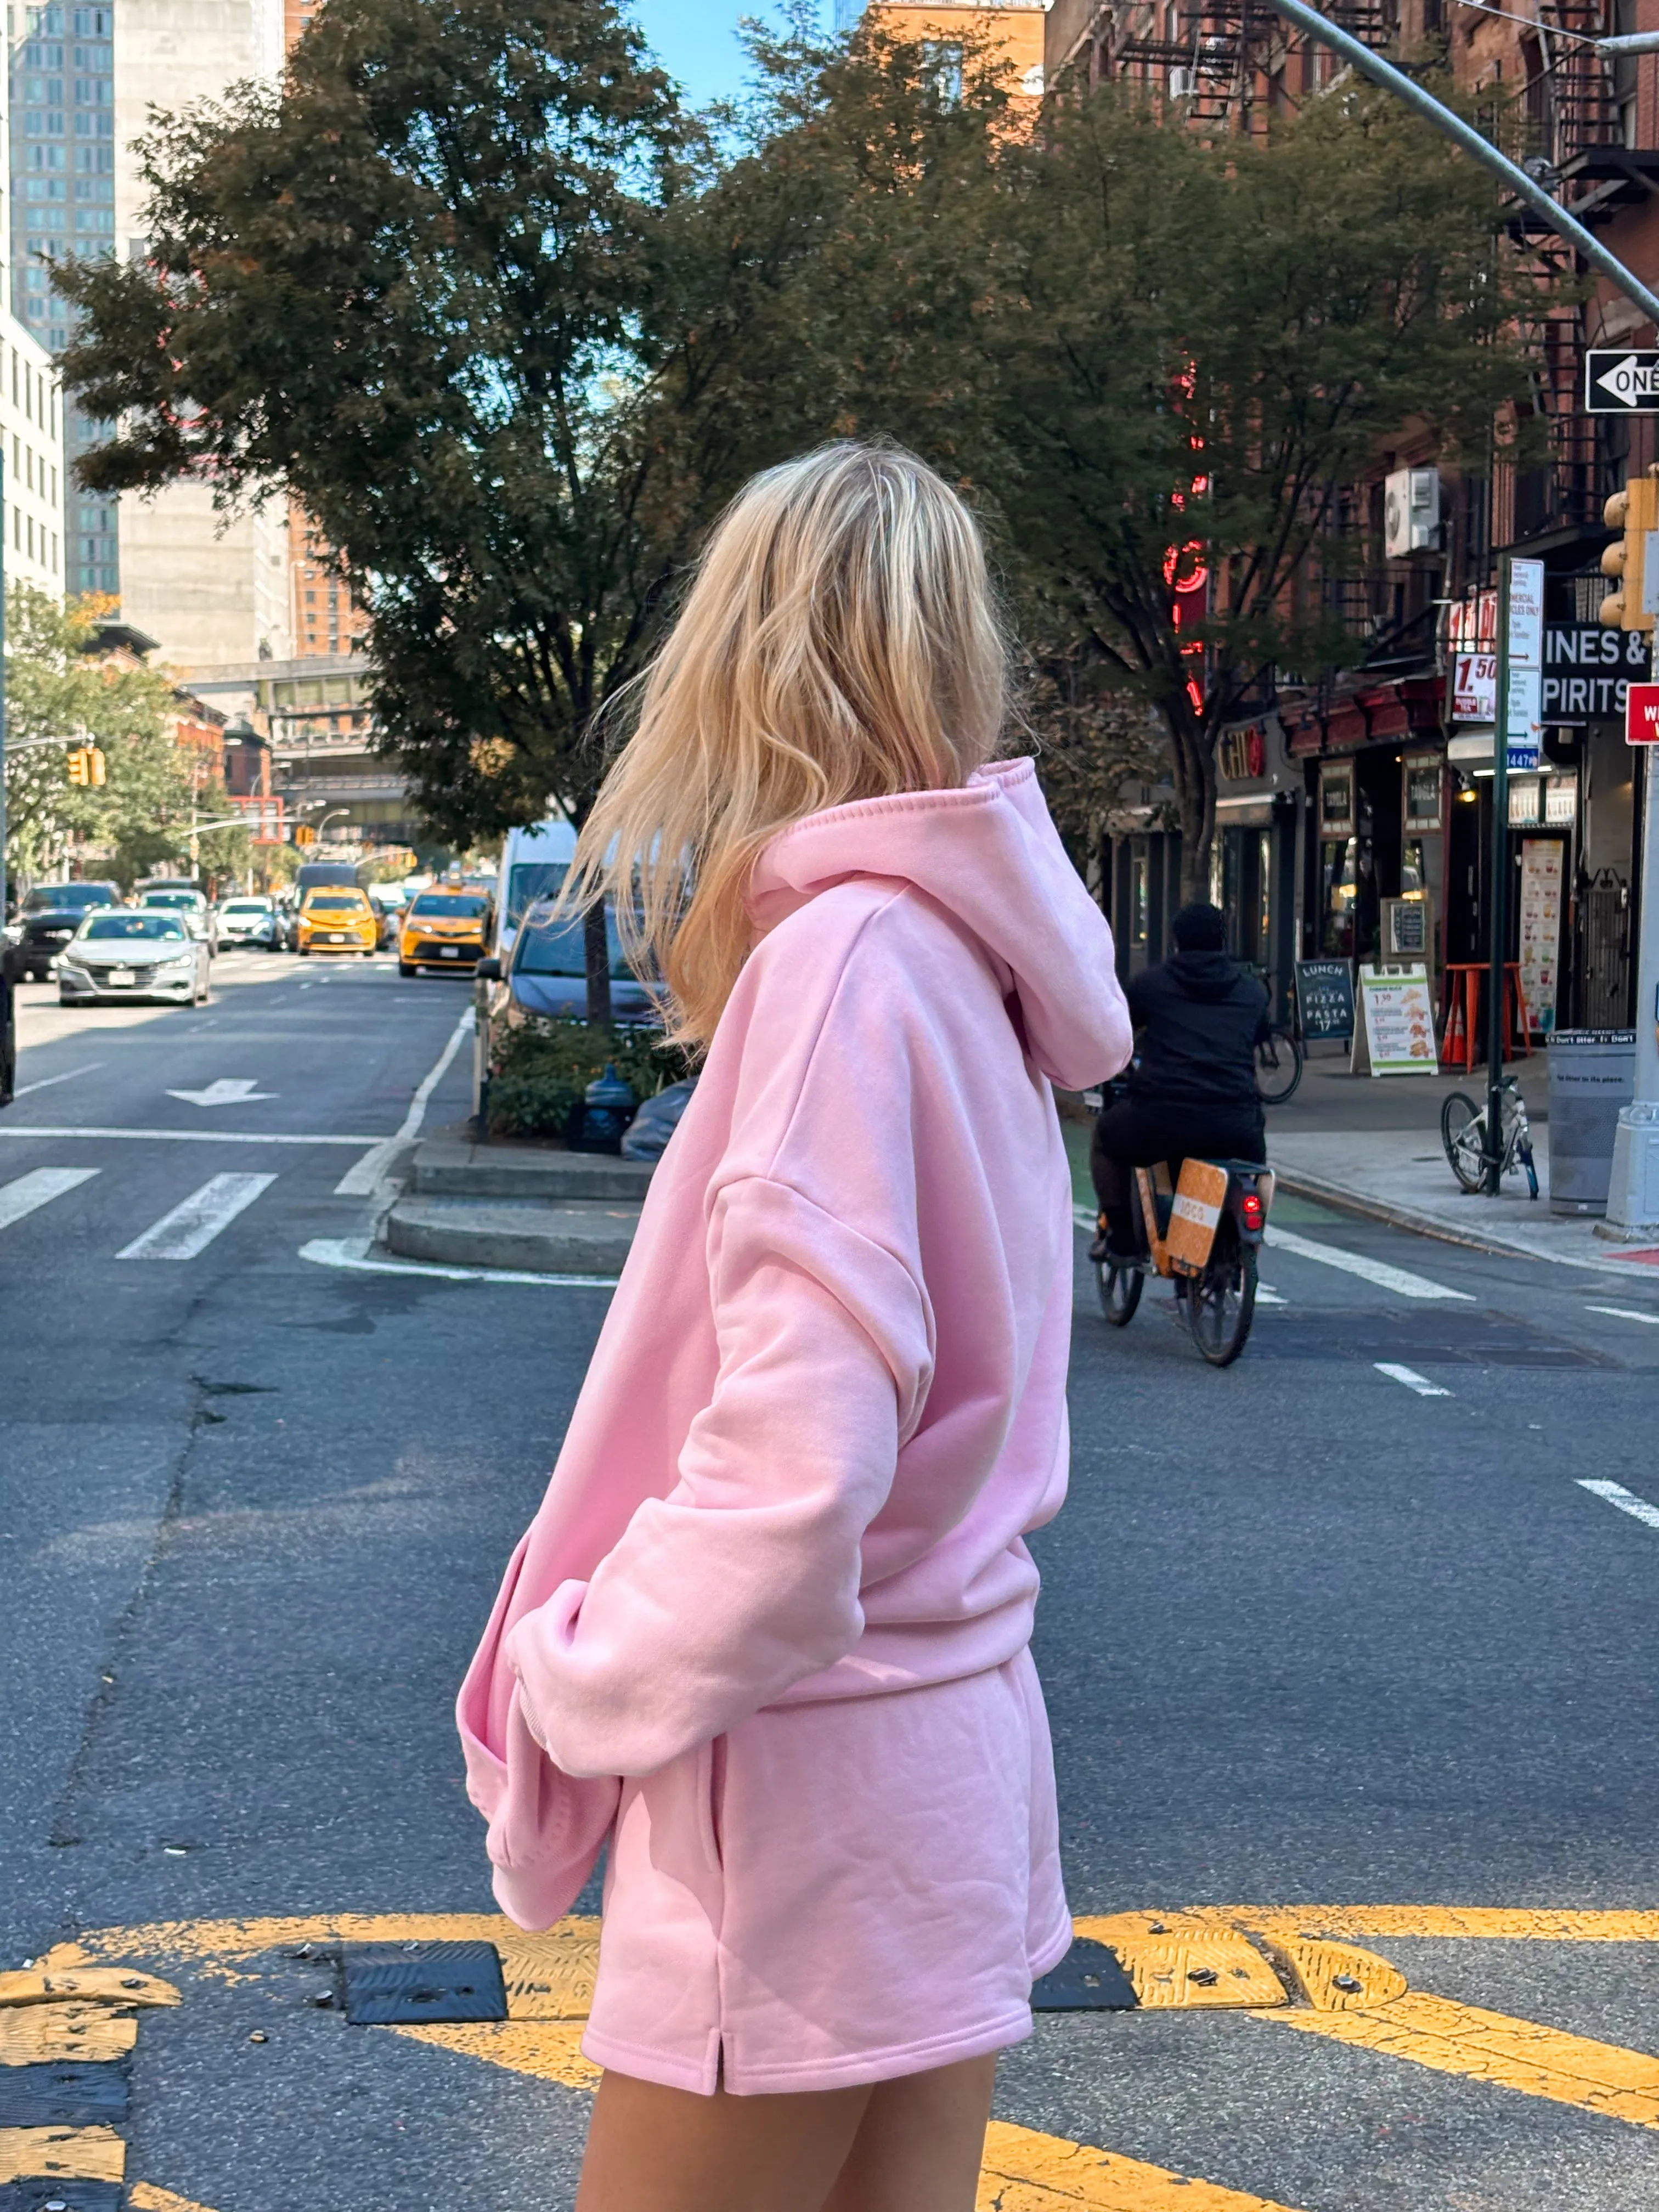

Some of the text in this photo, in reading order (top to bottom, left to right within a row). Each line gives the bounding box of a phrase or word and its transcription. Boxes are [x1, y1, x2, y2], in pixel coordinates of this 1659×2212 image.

[1616, 370, 1659, 392] ONE
[1546, 630, 1646, 665] INES &
[1542, 678, 1627, 713] PIRITS
[1302, 964, 1343, 977] LUNCH
[1306, 992, 1345, 1004] PIZZA
[1307, 1008, 1347, 1019] PASTA
